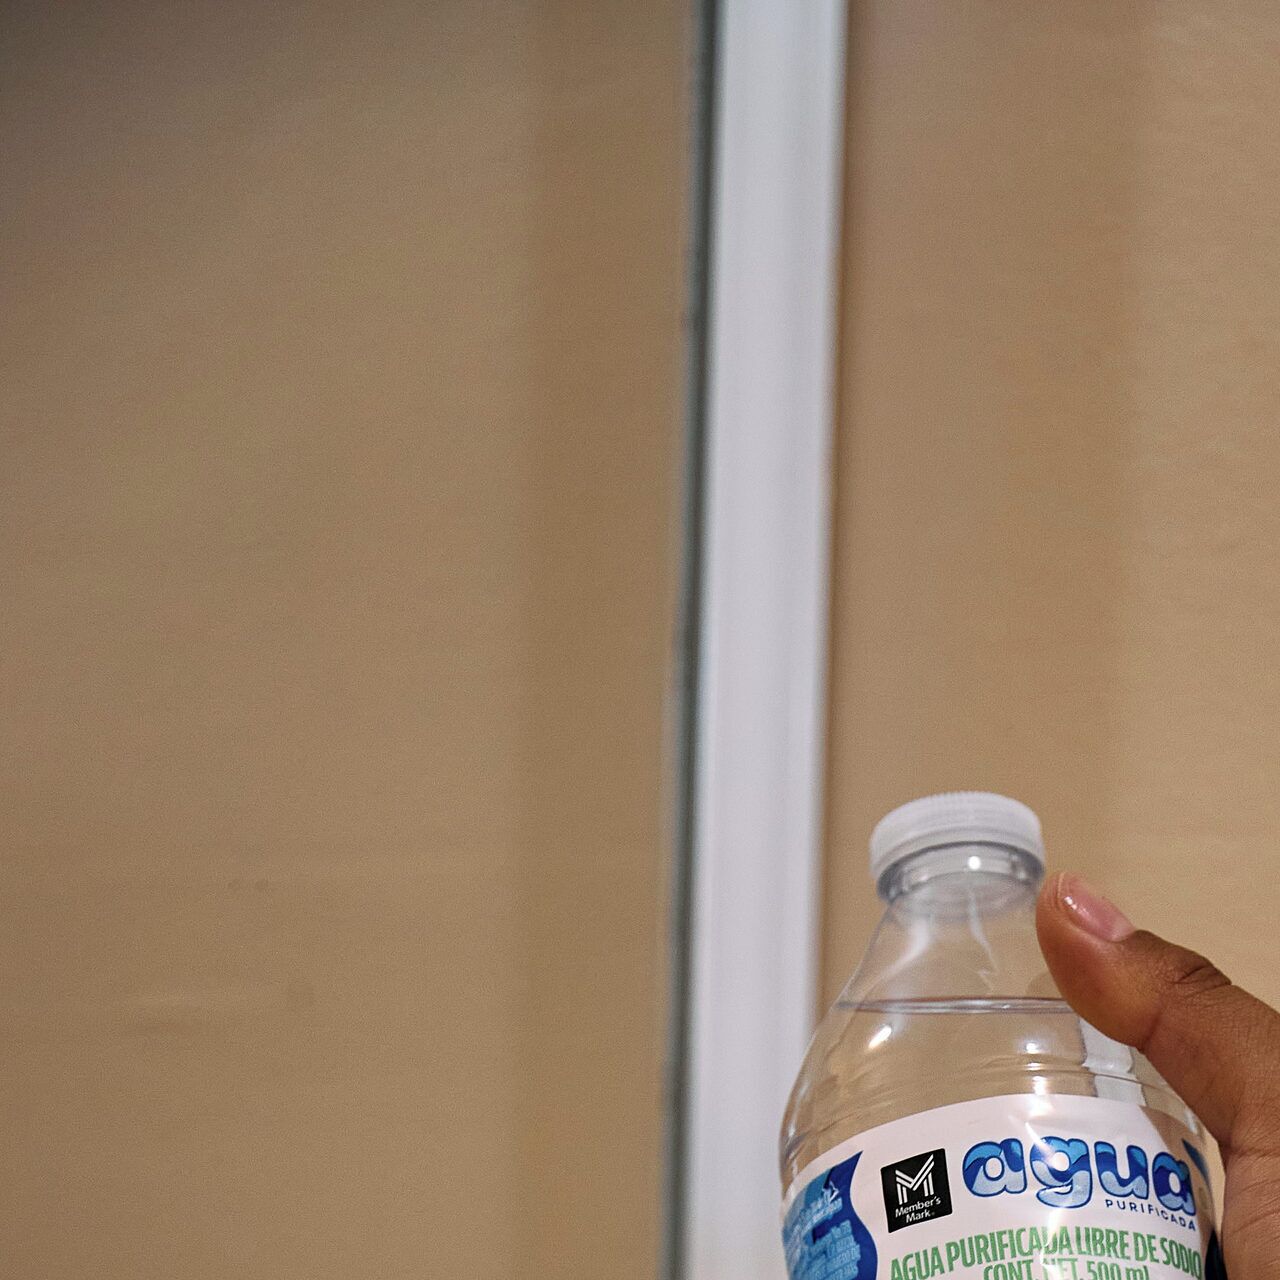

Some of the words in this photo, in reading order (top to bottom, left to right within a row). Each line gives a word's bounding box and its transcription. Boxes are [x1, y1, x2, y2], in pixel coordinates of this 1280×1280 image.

[963, 1136, 1197, 1216] agua
[895, 1197, 941, 1218] Member's
[905, 1209, 932, 1224] Mark
[1105, 1199, 1196, 1231] PURIFICADA
[1074, 1226, 1131, 1260] LIBRE
[1133, 1232, 1160, 1263] DE
